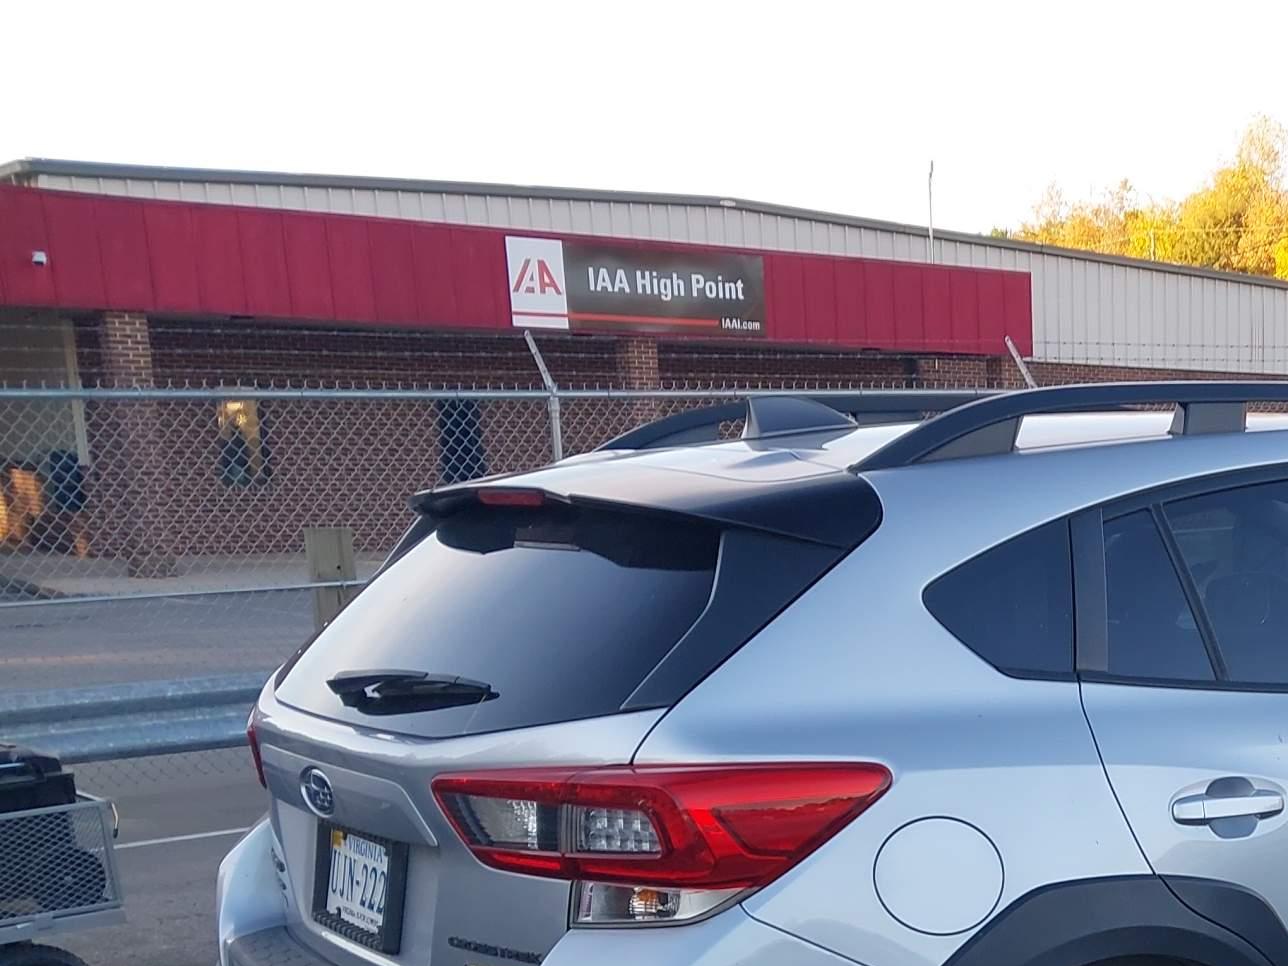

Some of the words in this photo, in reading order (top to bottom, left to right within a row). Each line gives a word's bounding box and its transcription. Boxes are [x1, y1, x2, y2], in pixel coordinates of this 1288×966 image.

[588, 267, 631, 294] IAA
[636, 270, 685, 301] High
[691, 274, 744, 300] Point
[721, 318, 760, 331] IAAI.com
[350, 838, 384, 863] VIRGINIA
